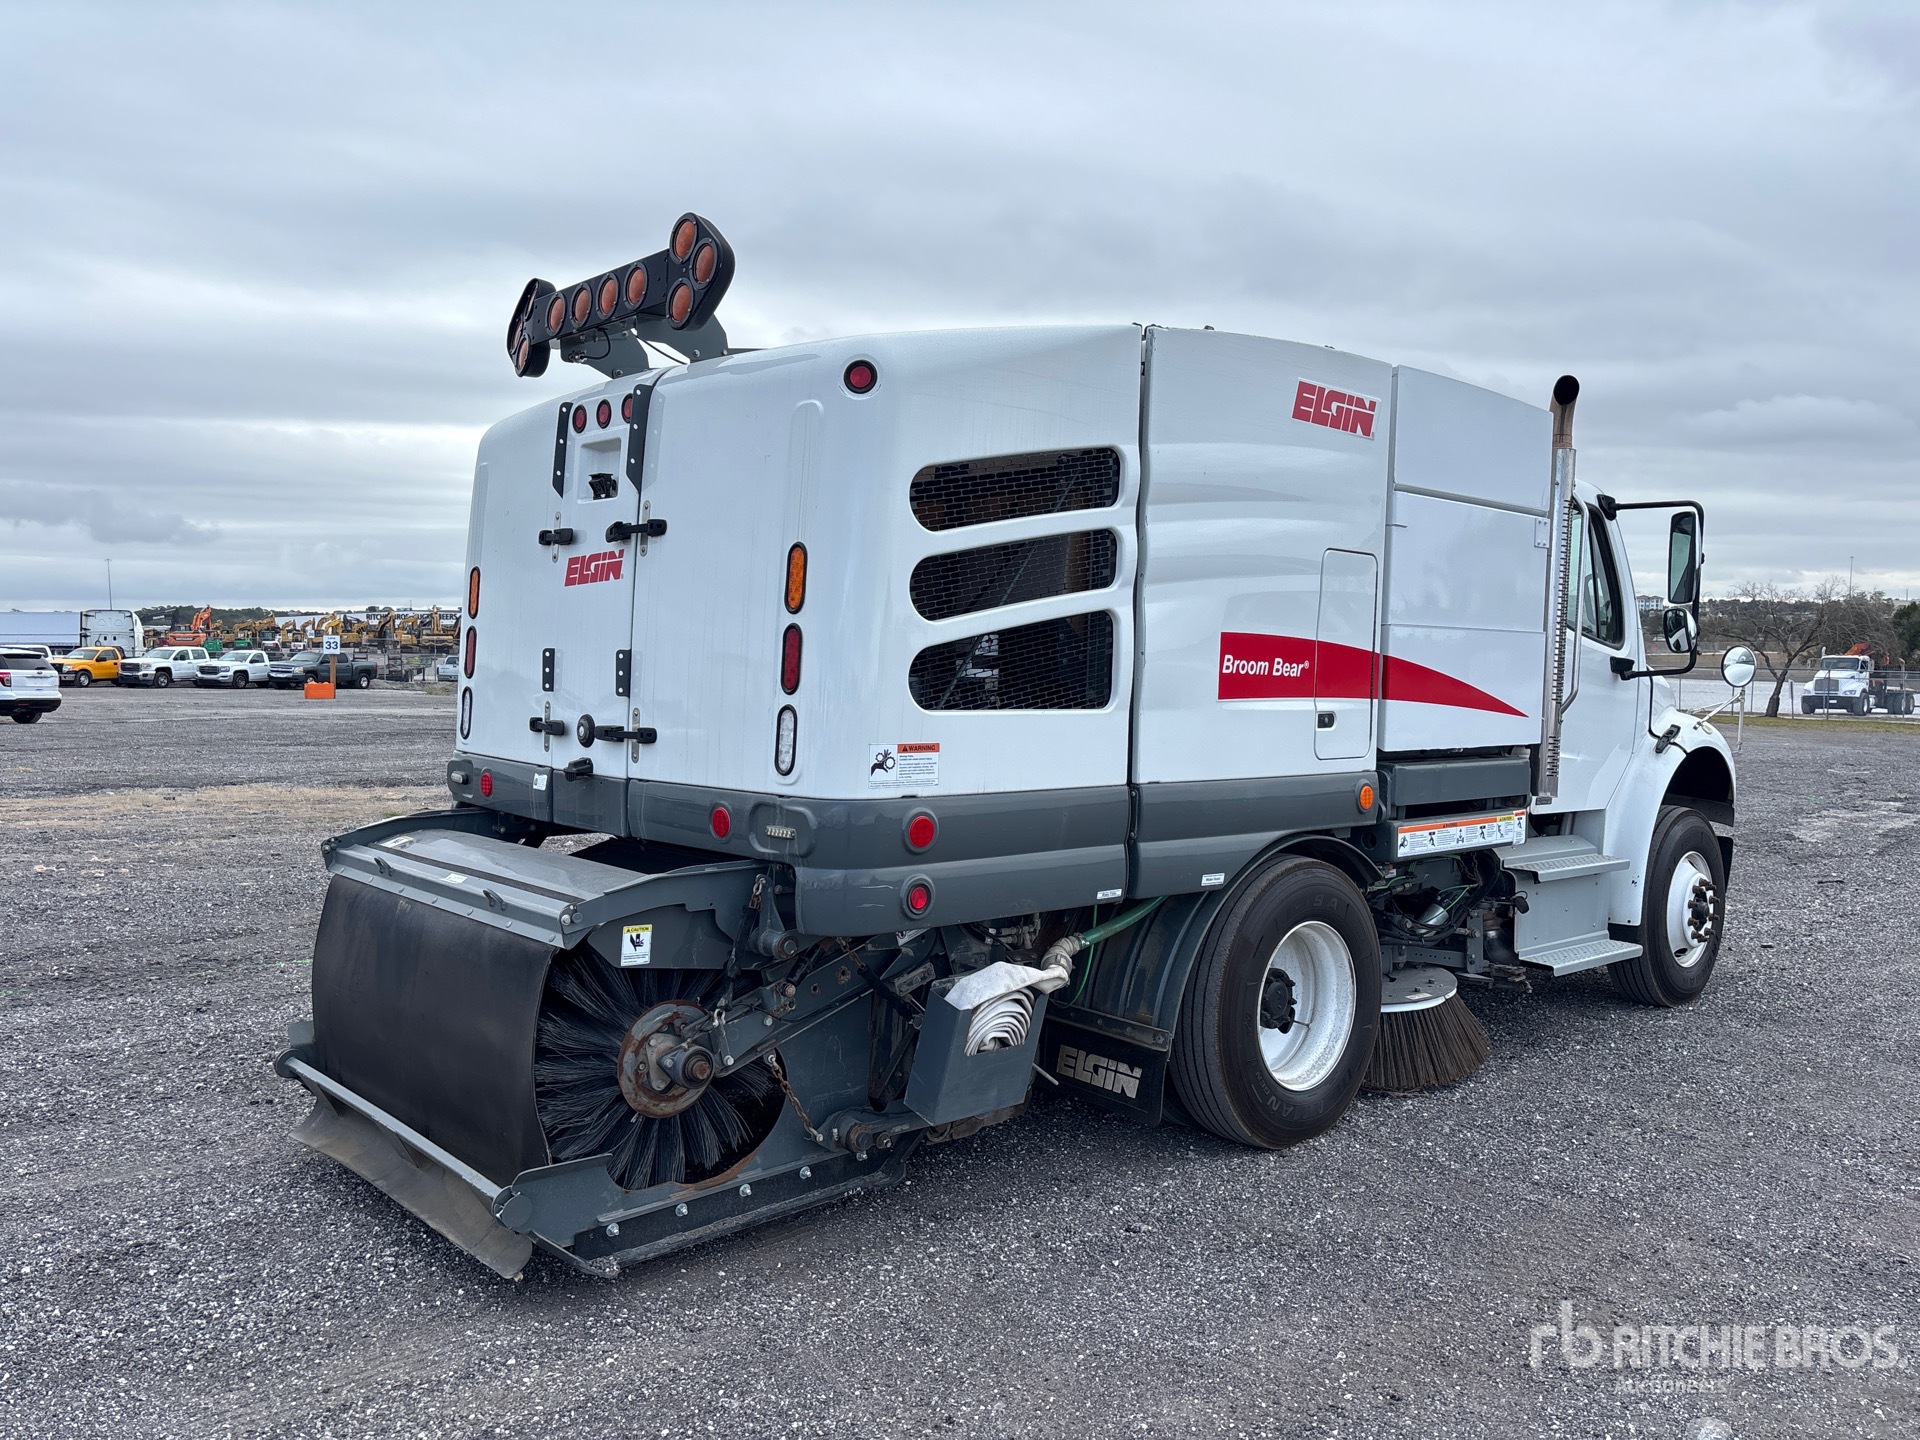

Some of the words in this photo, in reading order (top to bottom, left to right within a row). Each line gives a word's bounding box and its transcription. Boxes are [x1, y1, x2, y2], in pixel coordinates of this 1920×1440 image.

[1292, 380, 1376, 438] ELGIN
[565, 549, 624, 586] ELGIN
[325, 641, 338, 650] 33
[1222, 654, 1269, 675] Broom
[908, 744, 936, 752] WARNING
[1056, 1044, 1142, 1099] ELGIN
